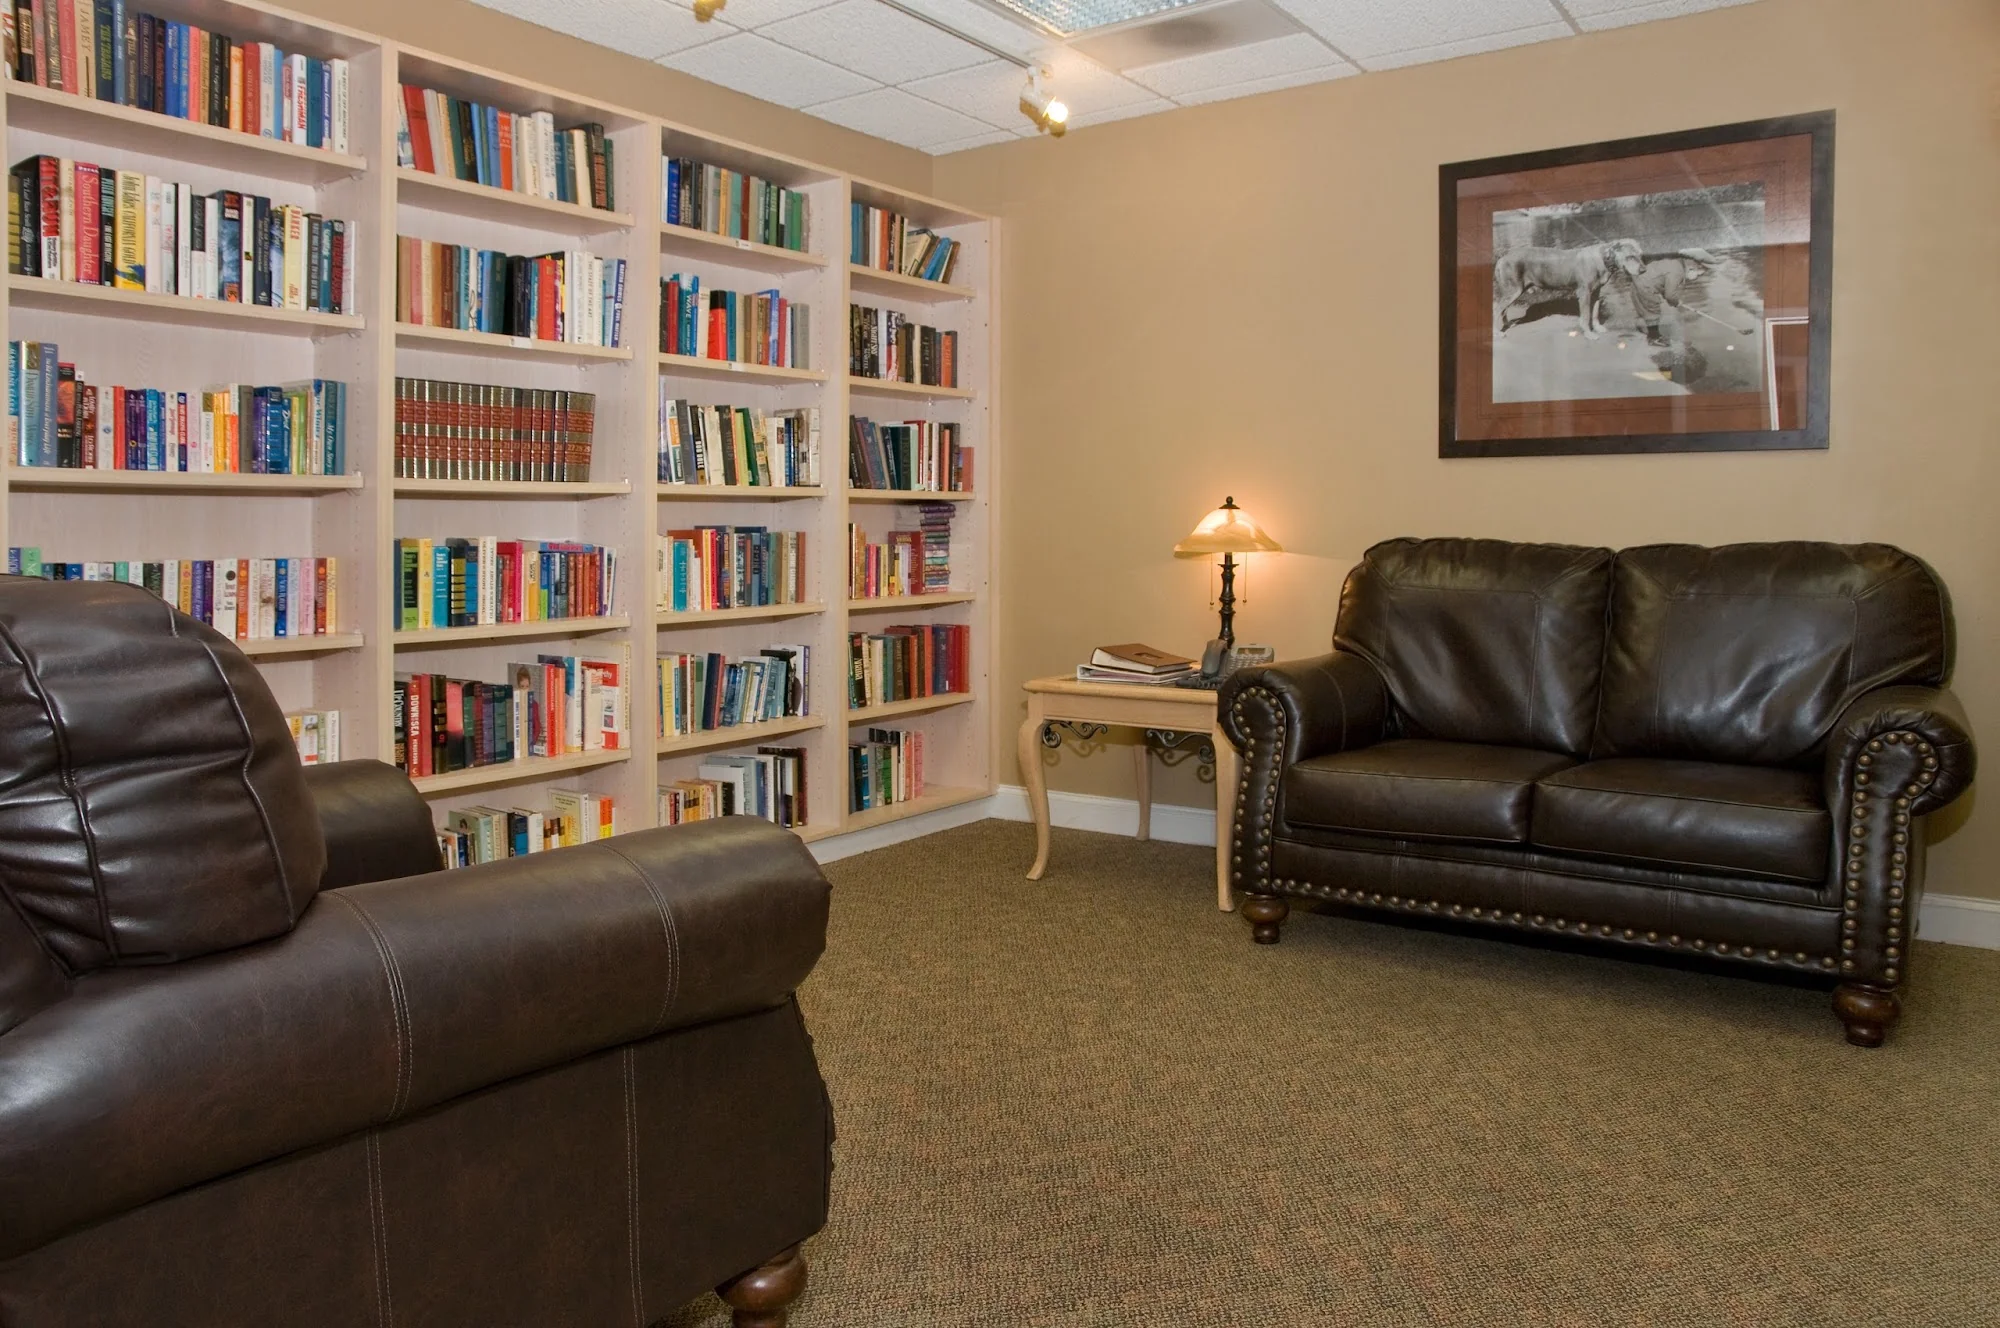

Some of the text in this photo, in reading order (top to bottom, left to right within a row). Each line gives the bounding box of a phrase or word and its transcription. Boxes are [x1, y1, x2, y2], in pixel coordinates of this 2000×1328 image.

[80, 175, 99, 276] Southern Daughter
[122, 246, 138, 265] GOLD
[870, 325, 878, 356] NIGHT SKY
[42, 417, 51, 443] Everyday
[326, 423, 336, 469] My Own Story
[695, 441, 705, 469] BOB DOLE
[410, 694, 420, 718] DOWN
[410, 721, 420, 737] SEA
